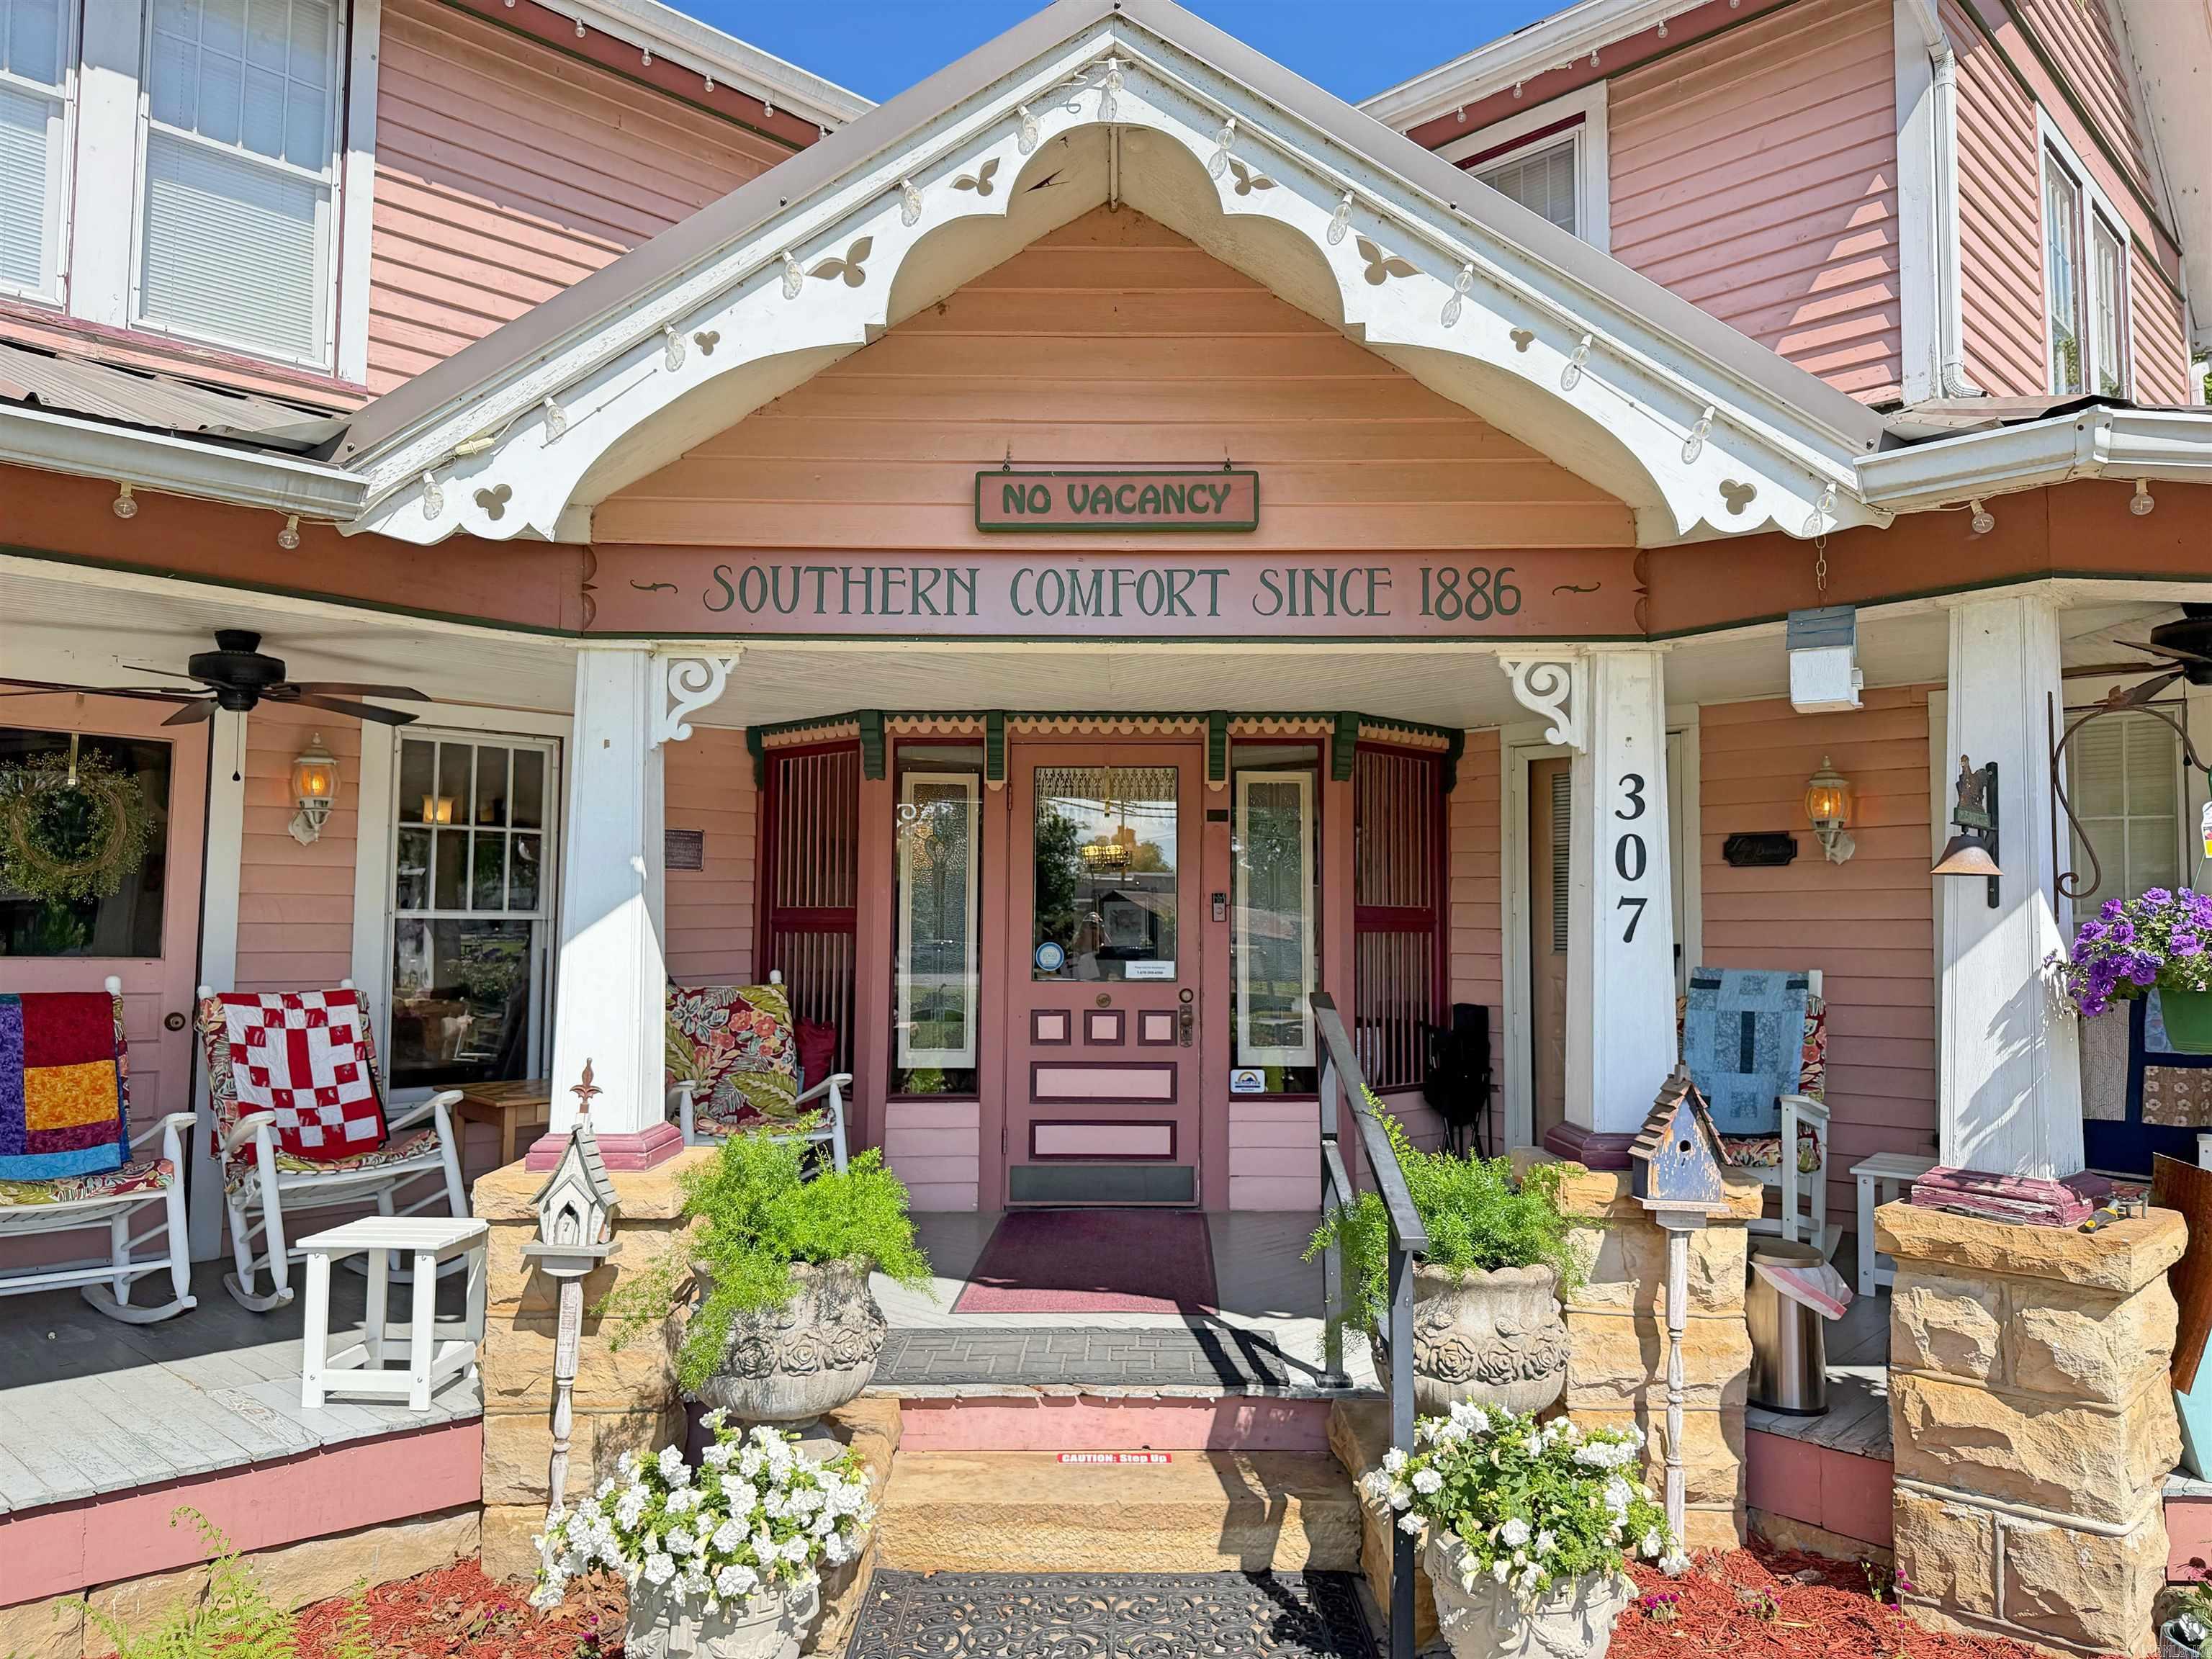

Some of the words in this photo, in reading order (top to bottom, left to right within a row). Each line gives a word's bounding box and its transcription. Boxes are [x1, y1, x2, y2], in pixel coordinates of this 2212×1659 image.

[1002, 484, 1051, 514] NO
[1067, 483, 1231, 514] VACANCY
[703, 565, 980, 616] SOUTHERN
[1010, 567, 1230, 618] COMFORT
[1252, 567, 1393, 618] SINCE
[1420, 566, 1521, 622] 1886
[1614, 773, 1649, 944] 307
[1061, 1453, 1117, 1462] CAUTION:
[1119, 1453, 1148, 1463] Step
[1150, 1453, 1167, 1463] Up
